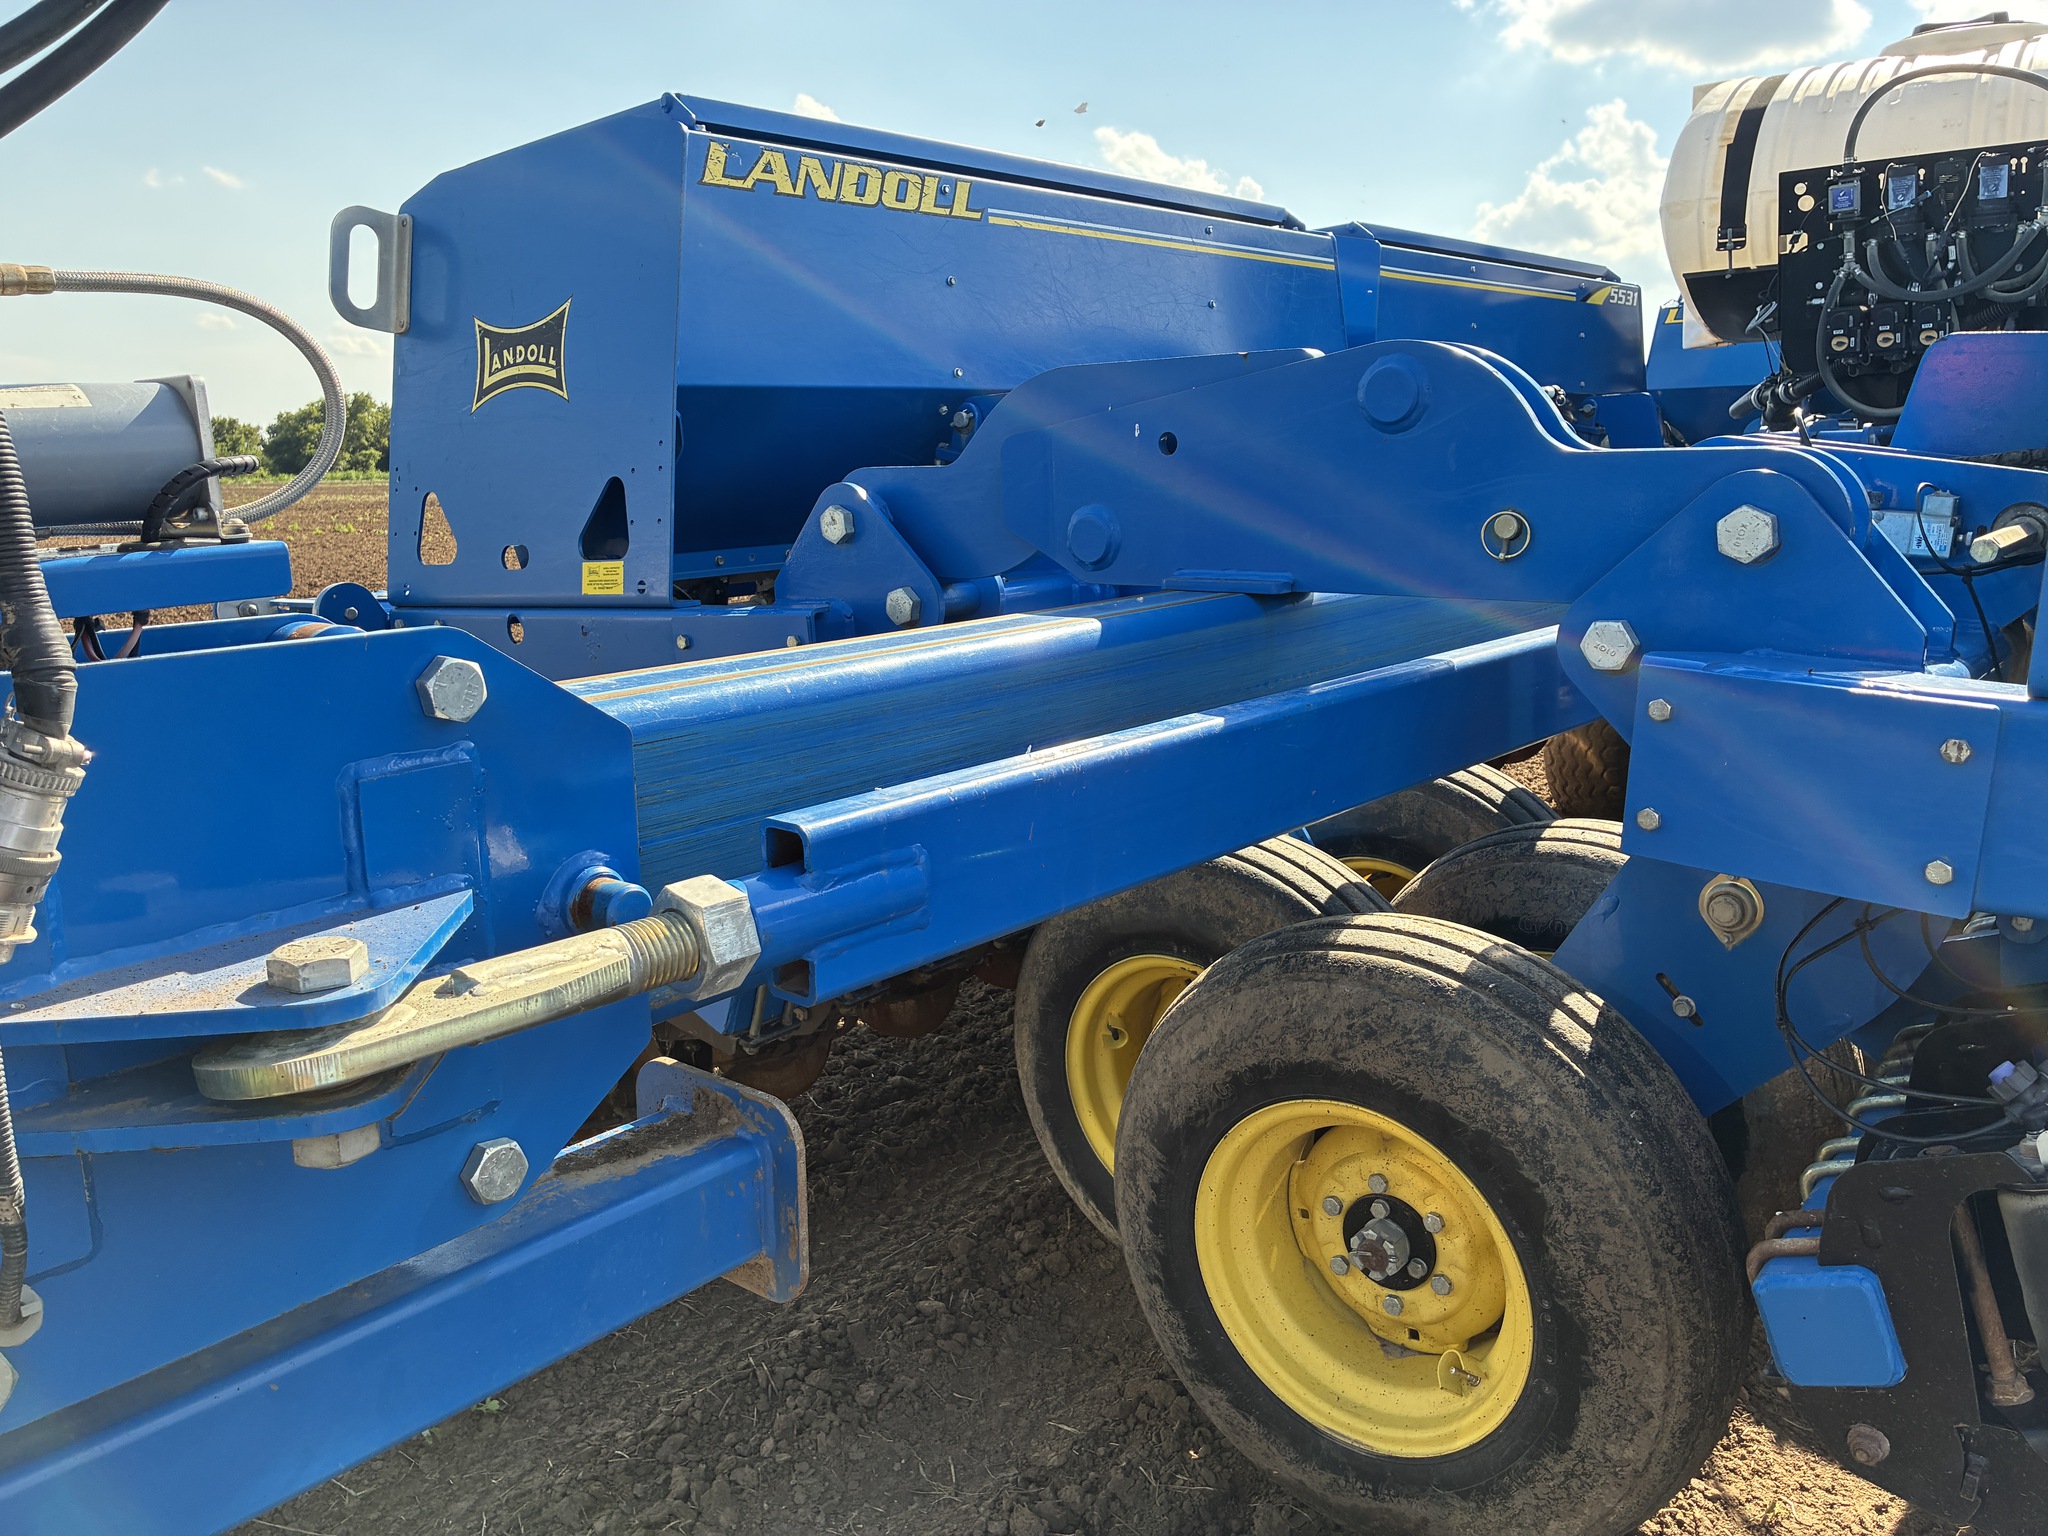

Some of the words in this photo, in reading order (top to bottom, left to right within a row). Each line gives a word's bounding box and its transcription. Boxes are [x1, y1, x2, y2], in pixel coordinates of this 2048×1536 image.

[700, 138, 984, 221] LANDOLL
[1609, 287, 1639, 307] 5531
[483, 337, 557, 389] LANDOLL
